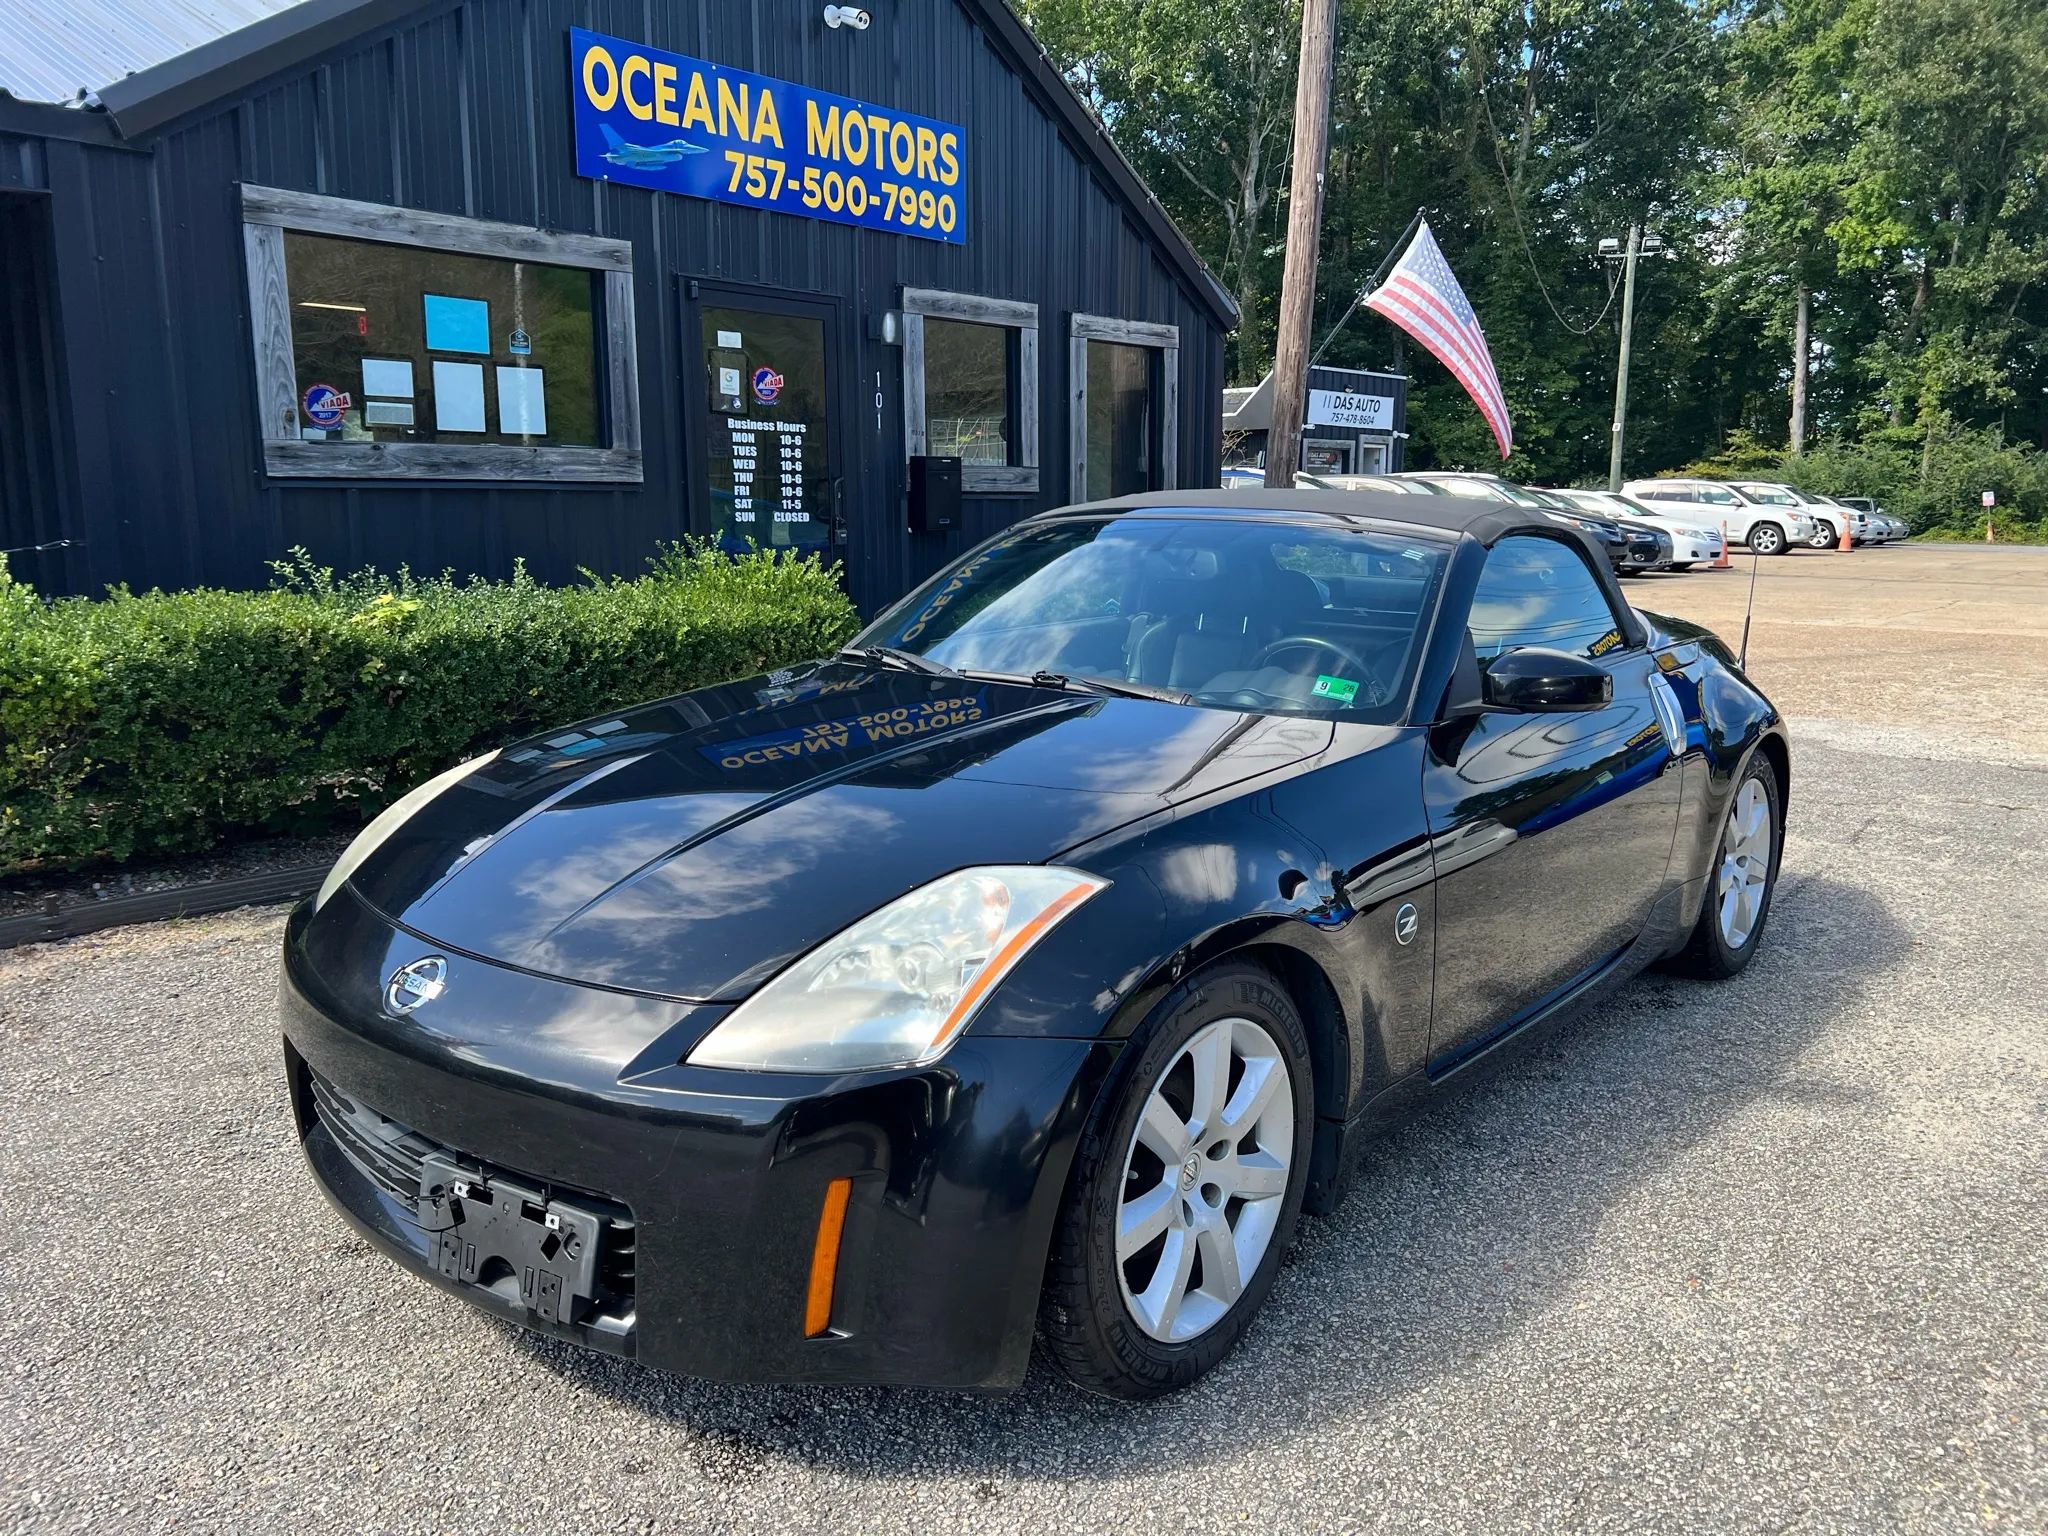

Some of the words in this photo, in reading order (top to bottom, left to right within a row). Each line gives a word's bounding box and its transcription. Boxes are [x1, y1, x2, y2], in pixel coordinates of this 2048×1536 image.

[583, 45, 784, 149] OCEANA
[807, 99, 960, 187] MOTORS
[724, 150, 956, 233] 757-500-7990
[320, 395, 349, 409] VIADA
[1334, 395, 1353, 410] DAS
[1355, 398, 1381, 413] AUTO
[727, 418, 775, 431] Business
[777, 421, 806, 433] Hours
[732, 432, 755, 444] MON
[780, 435, 802, 446] 10-6
[732, 446, 757, 457] TUES
[780, 448, 802, 459] 10-6
[733, 459, 756, 470] WED
[780, 460, 802, 472] 10-6
[733, 472, 754, 483] THU
[780, 473, 802, 484] 10-6
[734, 485, 750, 496] FRI
[781, 486, 803, 497] 10-6
[734, 498, 753, 509] SAT
[782, 499, 802, 510] 11-5
[735, 512, 756, 522] SUN
[774, 512, 810, 523] CLOSED
[1320, 681, 1328, 690] 9
[1260, 990, 1305, 1055] MICHELIN
